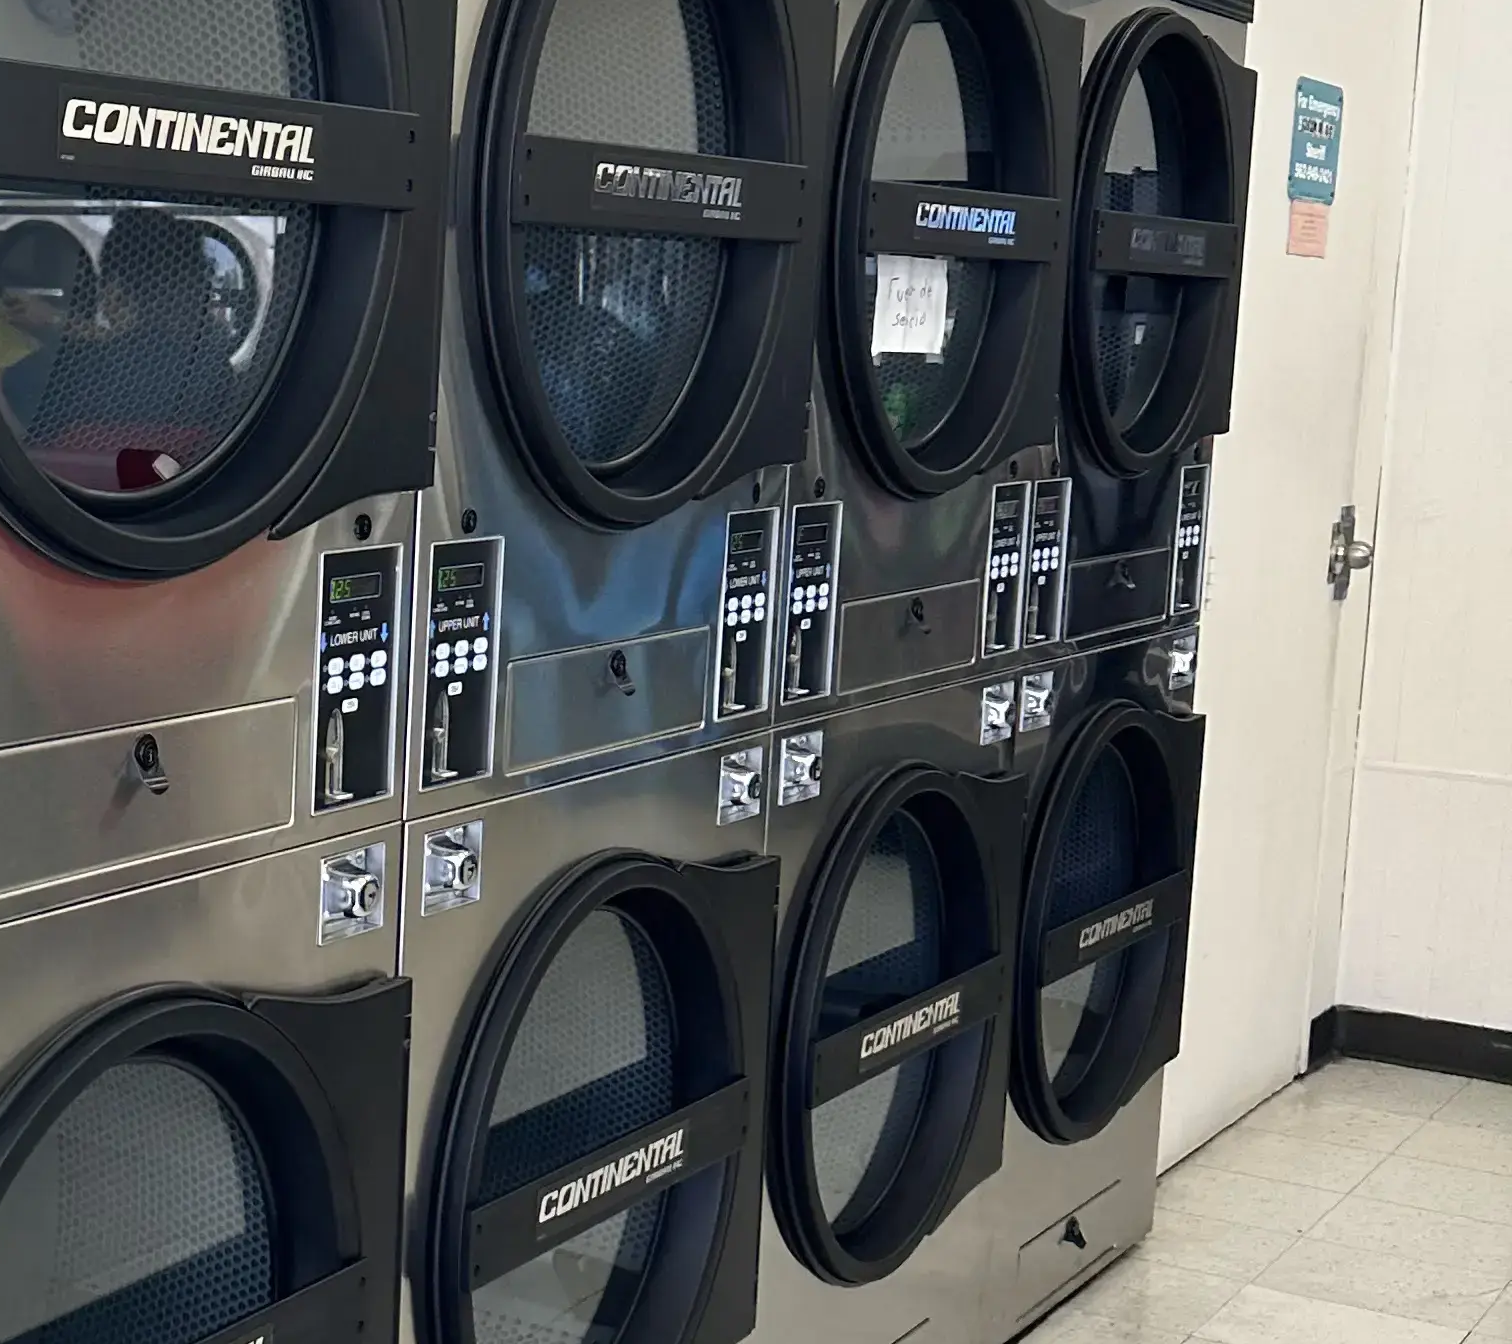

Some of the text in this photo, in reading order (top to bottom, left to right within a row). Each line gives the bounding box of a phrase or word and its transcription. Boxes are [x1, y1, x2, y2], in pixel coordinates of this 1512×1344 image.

[62, 98, 315, 164] CONTINENTAL
[594, 162, 742, 207] CONTINENTAL
[915, 202, 1016, 235] CONTINENTAL
[330, 627, 378, 647] LOWER UNIT
[438, 616, 480, 632] UPPER UNIT
[860, 991, 961, 1059] CONTINENTAL
[538, 1128, 684, 1224] CONTINENTAL
